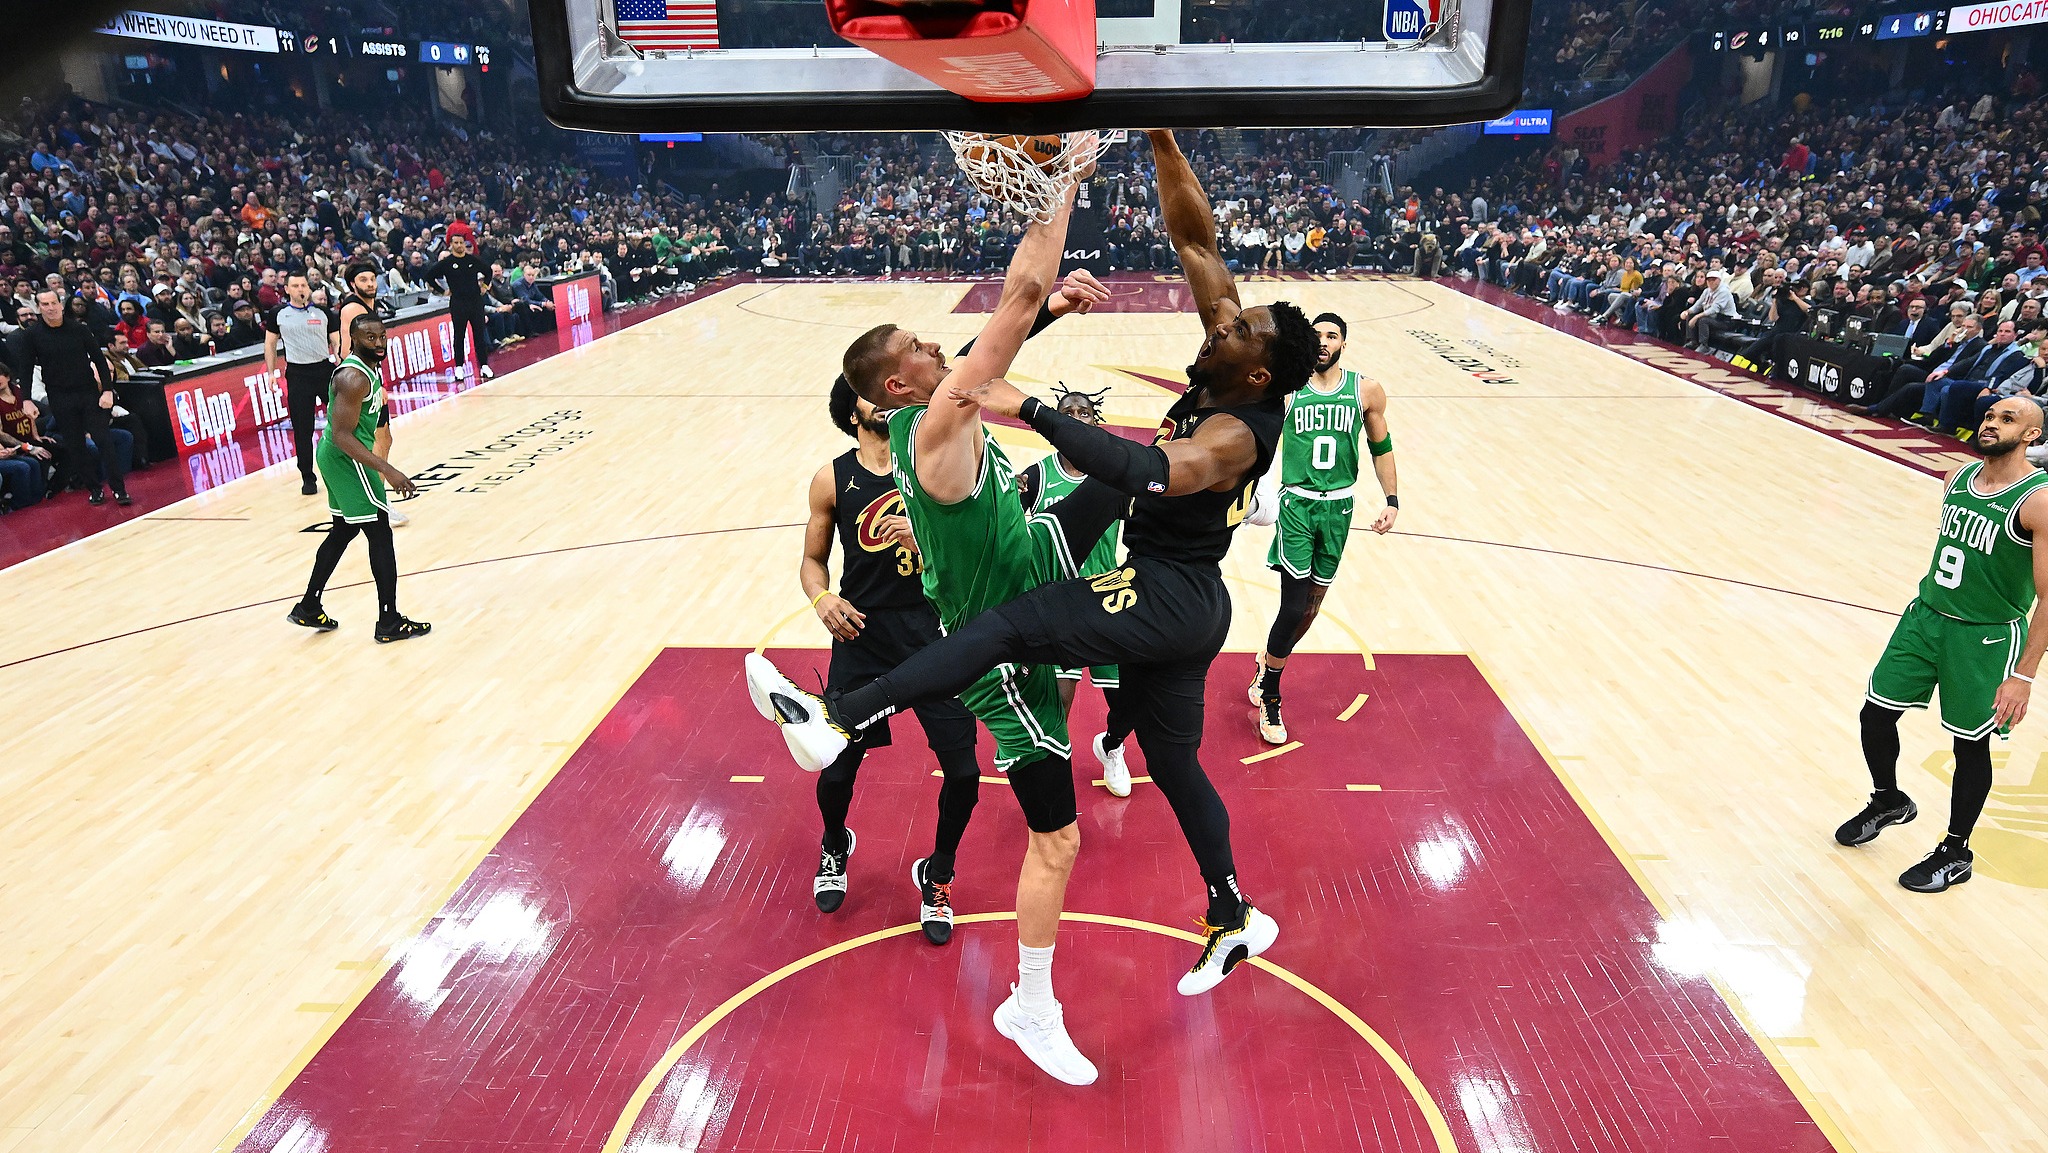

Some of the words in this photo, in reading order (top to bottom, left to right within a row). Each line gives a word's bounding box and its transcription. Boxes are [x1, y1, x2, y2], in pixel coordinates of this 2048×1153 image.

[122, 14, 166, 35] WHEN
[168, 19, 197, 39] YOU
[200, 24, 239, 44] NEED
[243, 29, 260, 46] IT.
[1391, 11, 1419, 33] NBA
[1890, 19, 1900, 34] 4
[1935, 20, 1943, 31] 2
[1758, 31, 1768, 46] 4
[1819, 27, 1844, 40] 7:16
[282, 38, 294, 52] 11
[328, 37, 338, 54] 1
[362, 41, 407, 57] ASSISTS
[430, 44, 441, 60] 0
[1714, 40, 1721, 51] 0
[477, 53, 489, 65] 16
[1520, 117, 1548, 127] ULTRA
[1064, 249, 1100, 260] KIA
[193, 387, 237, 440] App
[243, 368, 288, 427] THE
[404, 328, 435, 375] NBA
[17, 418, 31, 436] 45
[1294, 403, 1356, 435] BOSTON
[450, 410, 582, 460] Mortgage
[1311, 435, 1337, 470] 0
[455, 430, 594, 493] FIELDHOUSE
[1986, 501, 2009, 514] Amica
[1933, 544, 1966, 590] 9
